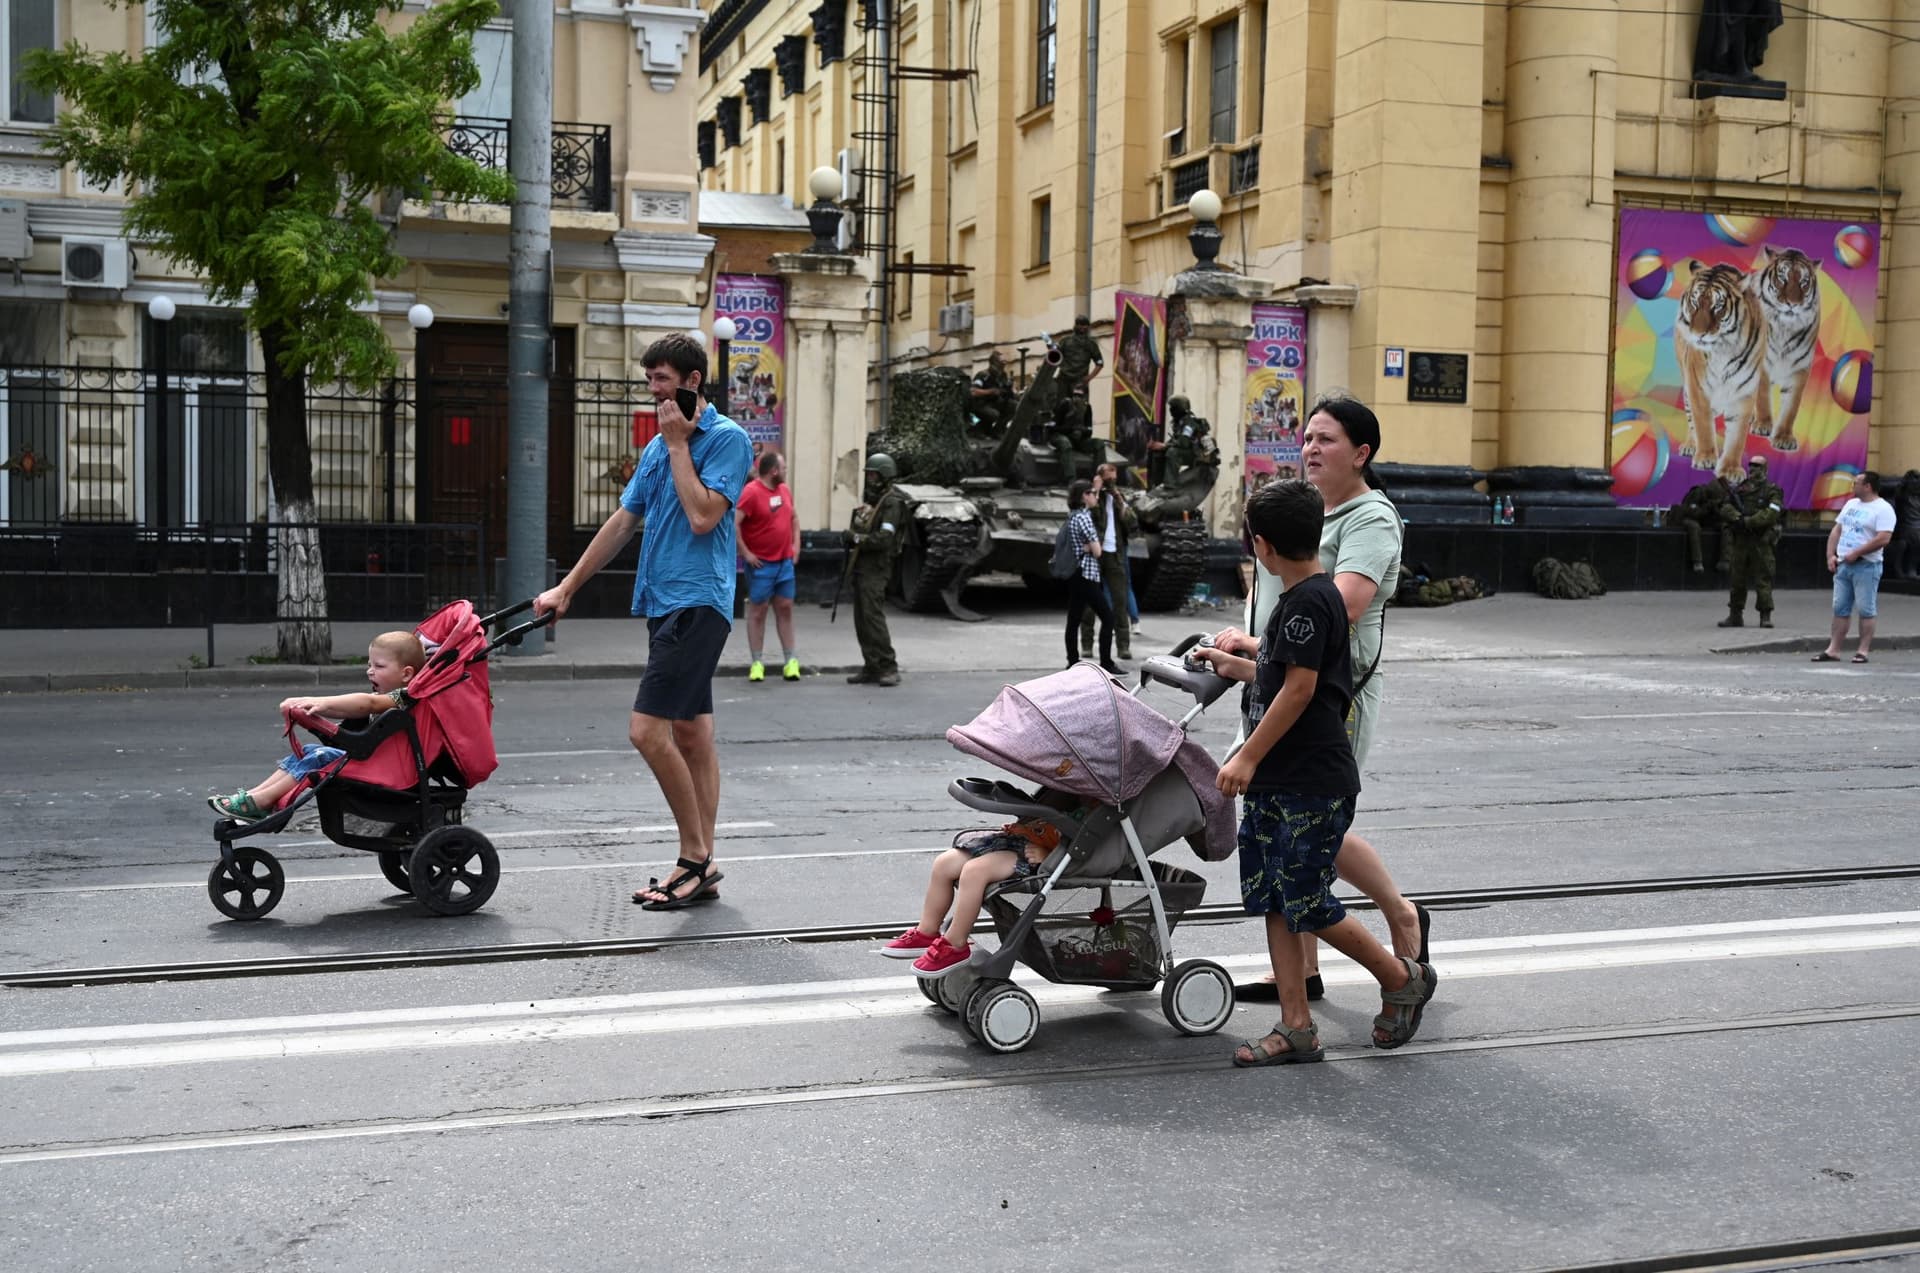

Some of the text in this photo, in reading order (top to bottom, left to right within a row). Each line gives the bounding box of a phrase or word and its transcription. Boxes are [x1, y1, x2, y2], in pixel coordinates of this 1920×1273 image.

[716, 294, 778, 313] ЦИРК
[734, 317, 773, 342] 29
[728, 346, 761, 355] преля
[1265, 345, 1301, 368] 28
